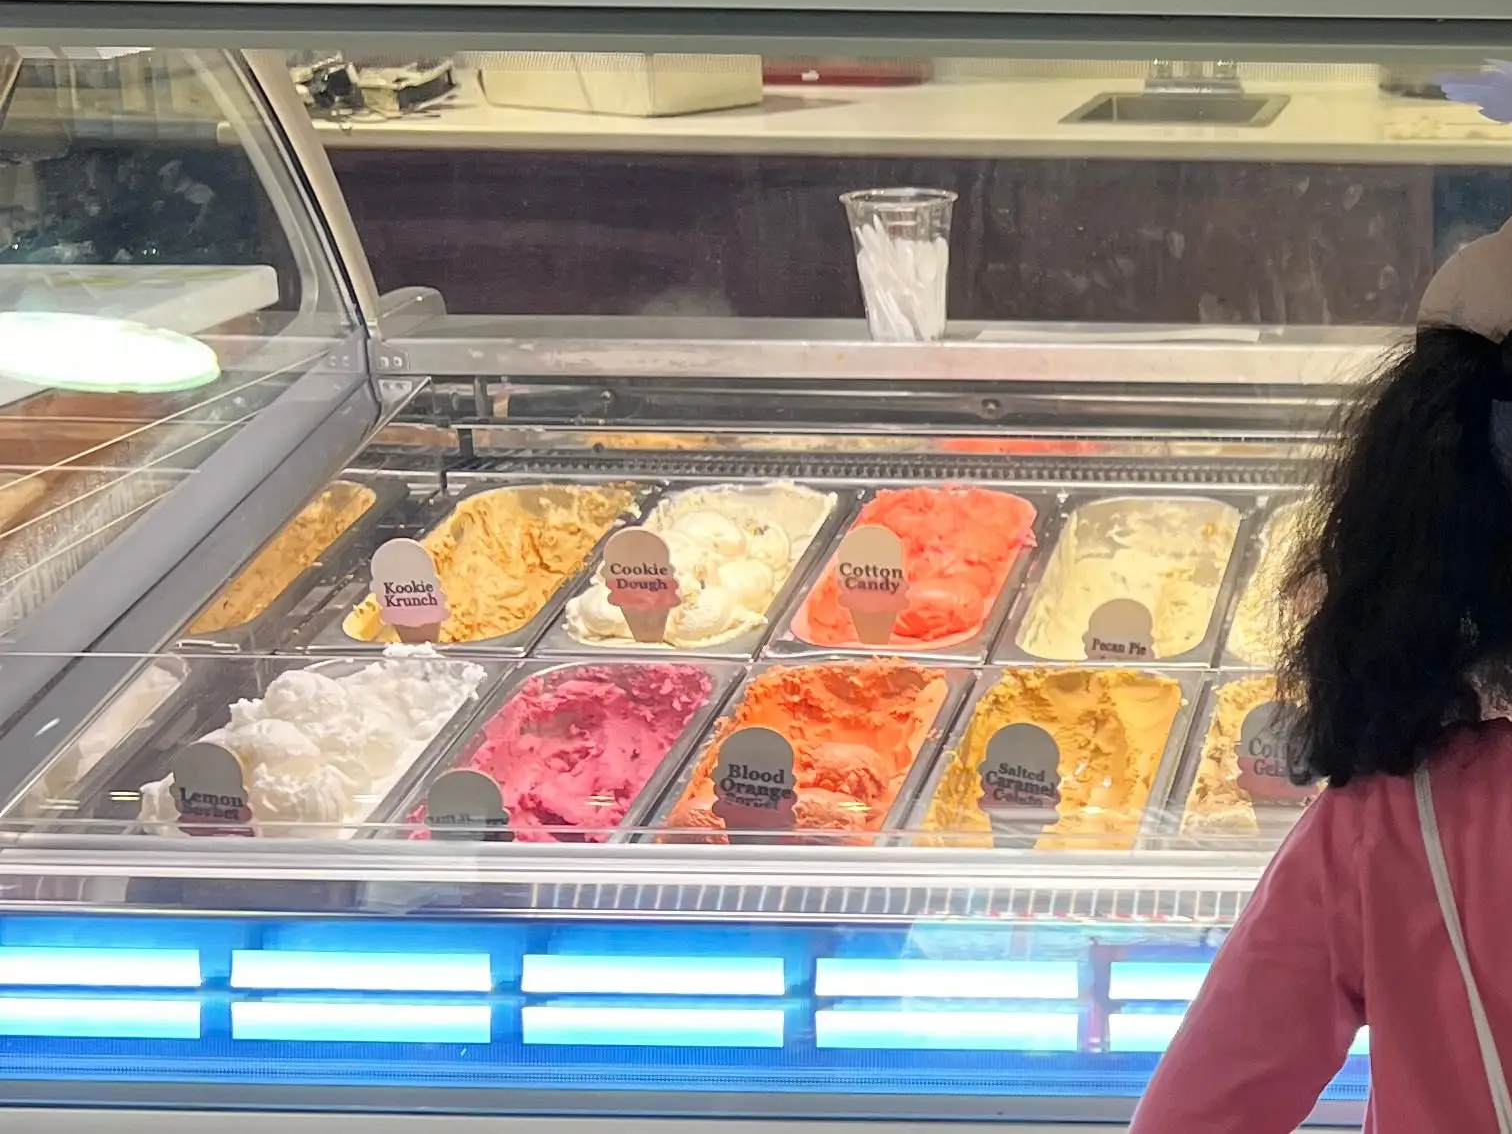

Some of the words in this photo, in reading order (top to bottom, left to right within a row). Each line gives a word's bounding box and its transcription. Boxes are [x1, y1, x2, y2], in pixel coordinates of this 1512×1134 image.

[610, 562, 668, 576] Cookie
[839, 562, 903, 579] Cotton
[384, 581, 433, 595] Kookie
[616, 577, 668, 592] Dough
[846, 577, 900, 595] Candy
[385, 595, 438, 608] Krunch
[1092, 638, 1125, 653] Pecan
[1128, 641, 1147, 654] Pie
[728, 764, 785, 784] Blood
[999, 762, 1045, 782] Salted
[720, 777, 792, 801] Orange
[985, 770, 1055, 797] Caramel
[180, 787, 244, 807] Lemon
